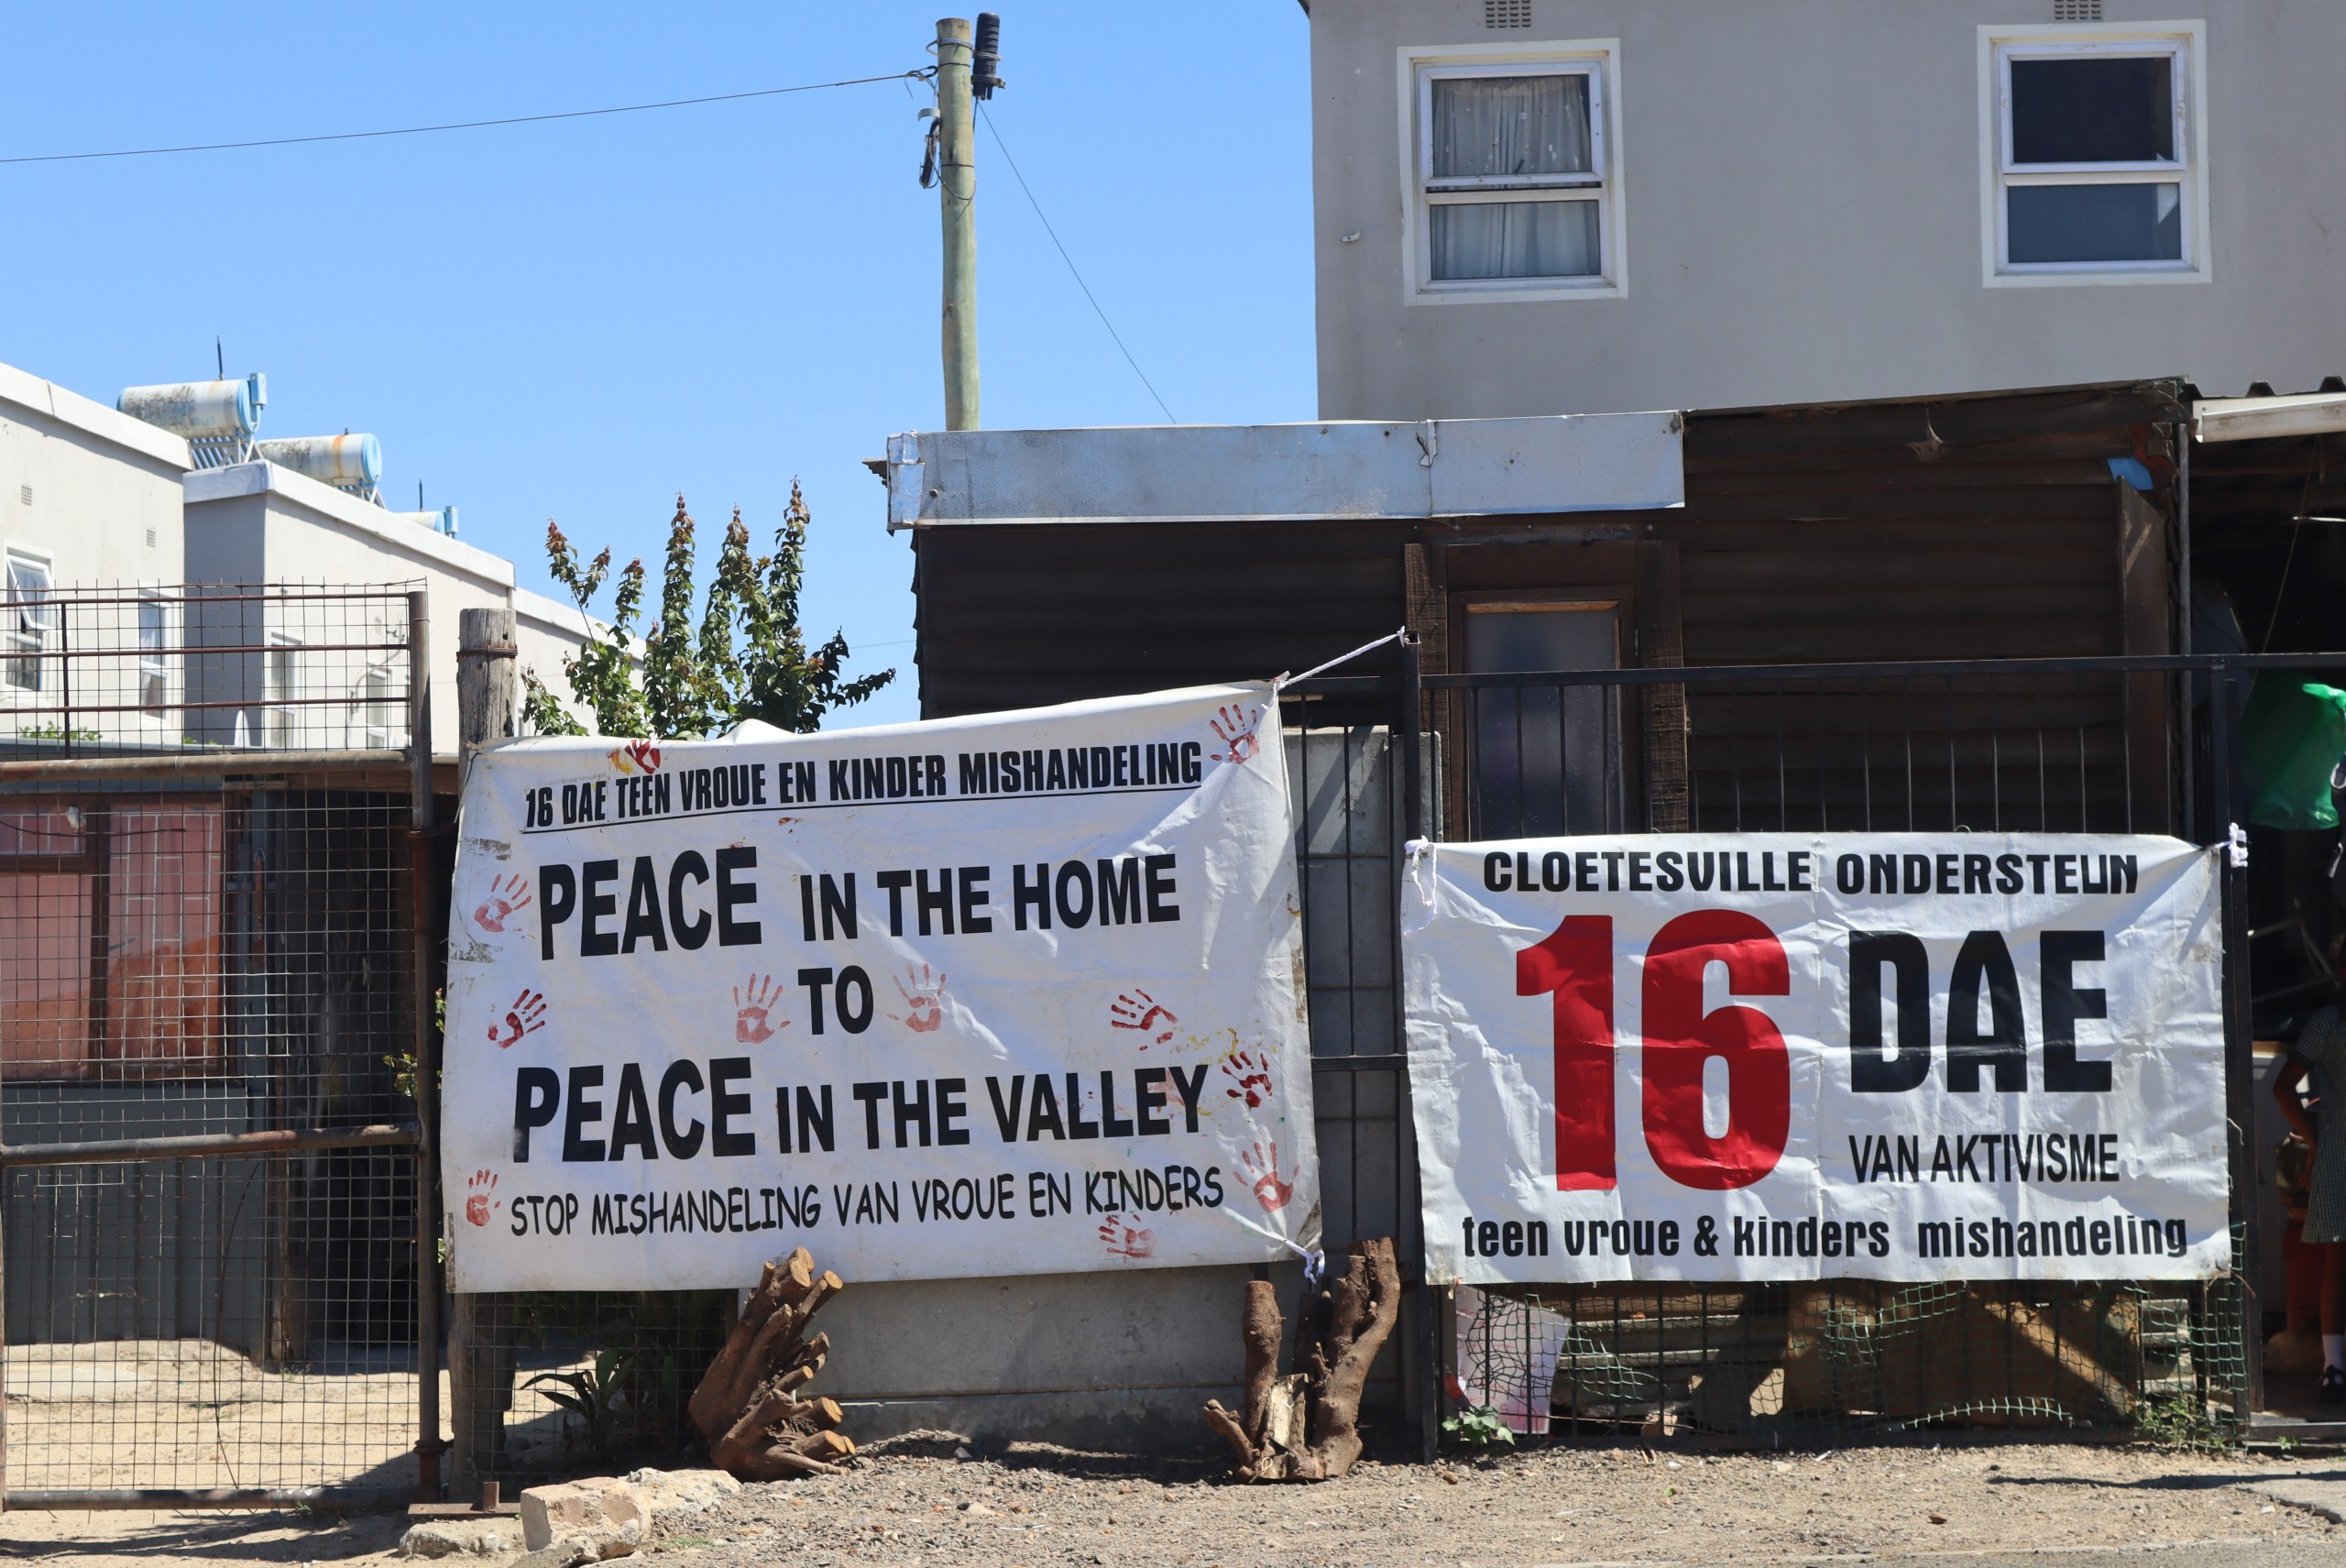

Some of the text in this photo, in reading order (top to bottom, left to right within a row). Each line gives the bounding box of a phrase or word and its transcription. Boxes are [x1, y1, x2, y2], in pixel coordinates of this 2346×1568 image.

[526, 742, 1200, 828] 16 DAE TEEN VROUE EN KINDER MISHANDELING
[540, 844, 1179, 960] PEACE IN THE HOME
[1485, 852, 1811, 892] CLOETESVILLE
[798, 965, 873, 1035] TO
[1517, 910, 2111, 1190] 16 DAE
[513, 1058, 1209, 1163] PEACE IN THE VALLEY
[1848, 1134, 2120, 1182] VAN AKTIVISME
[511, 1166, 1223, 1236] STOP MISHANDELING VAN VROUE EN KINDERS
[1463, 1215, 2187, 1257] teen vroue & kinders mishandeling
